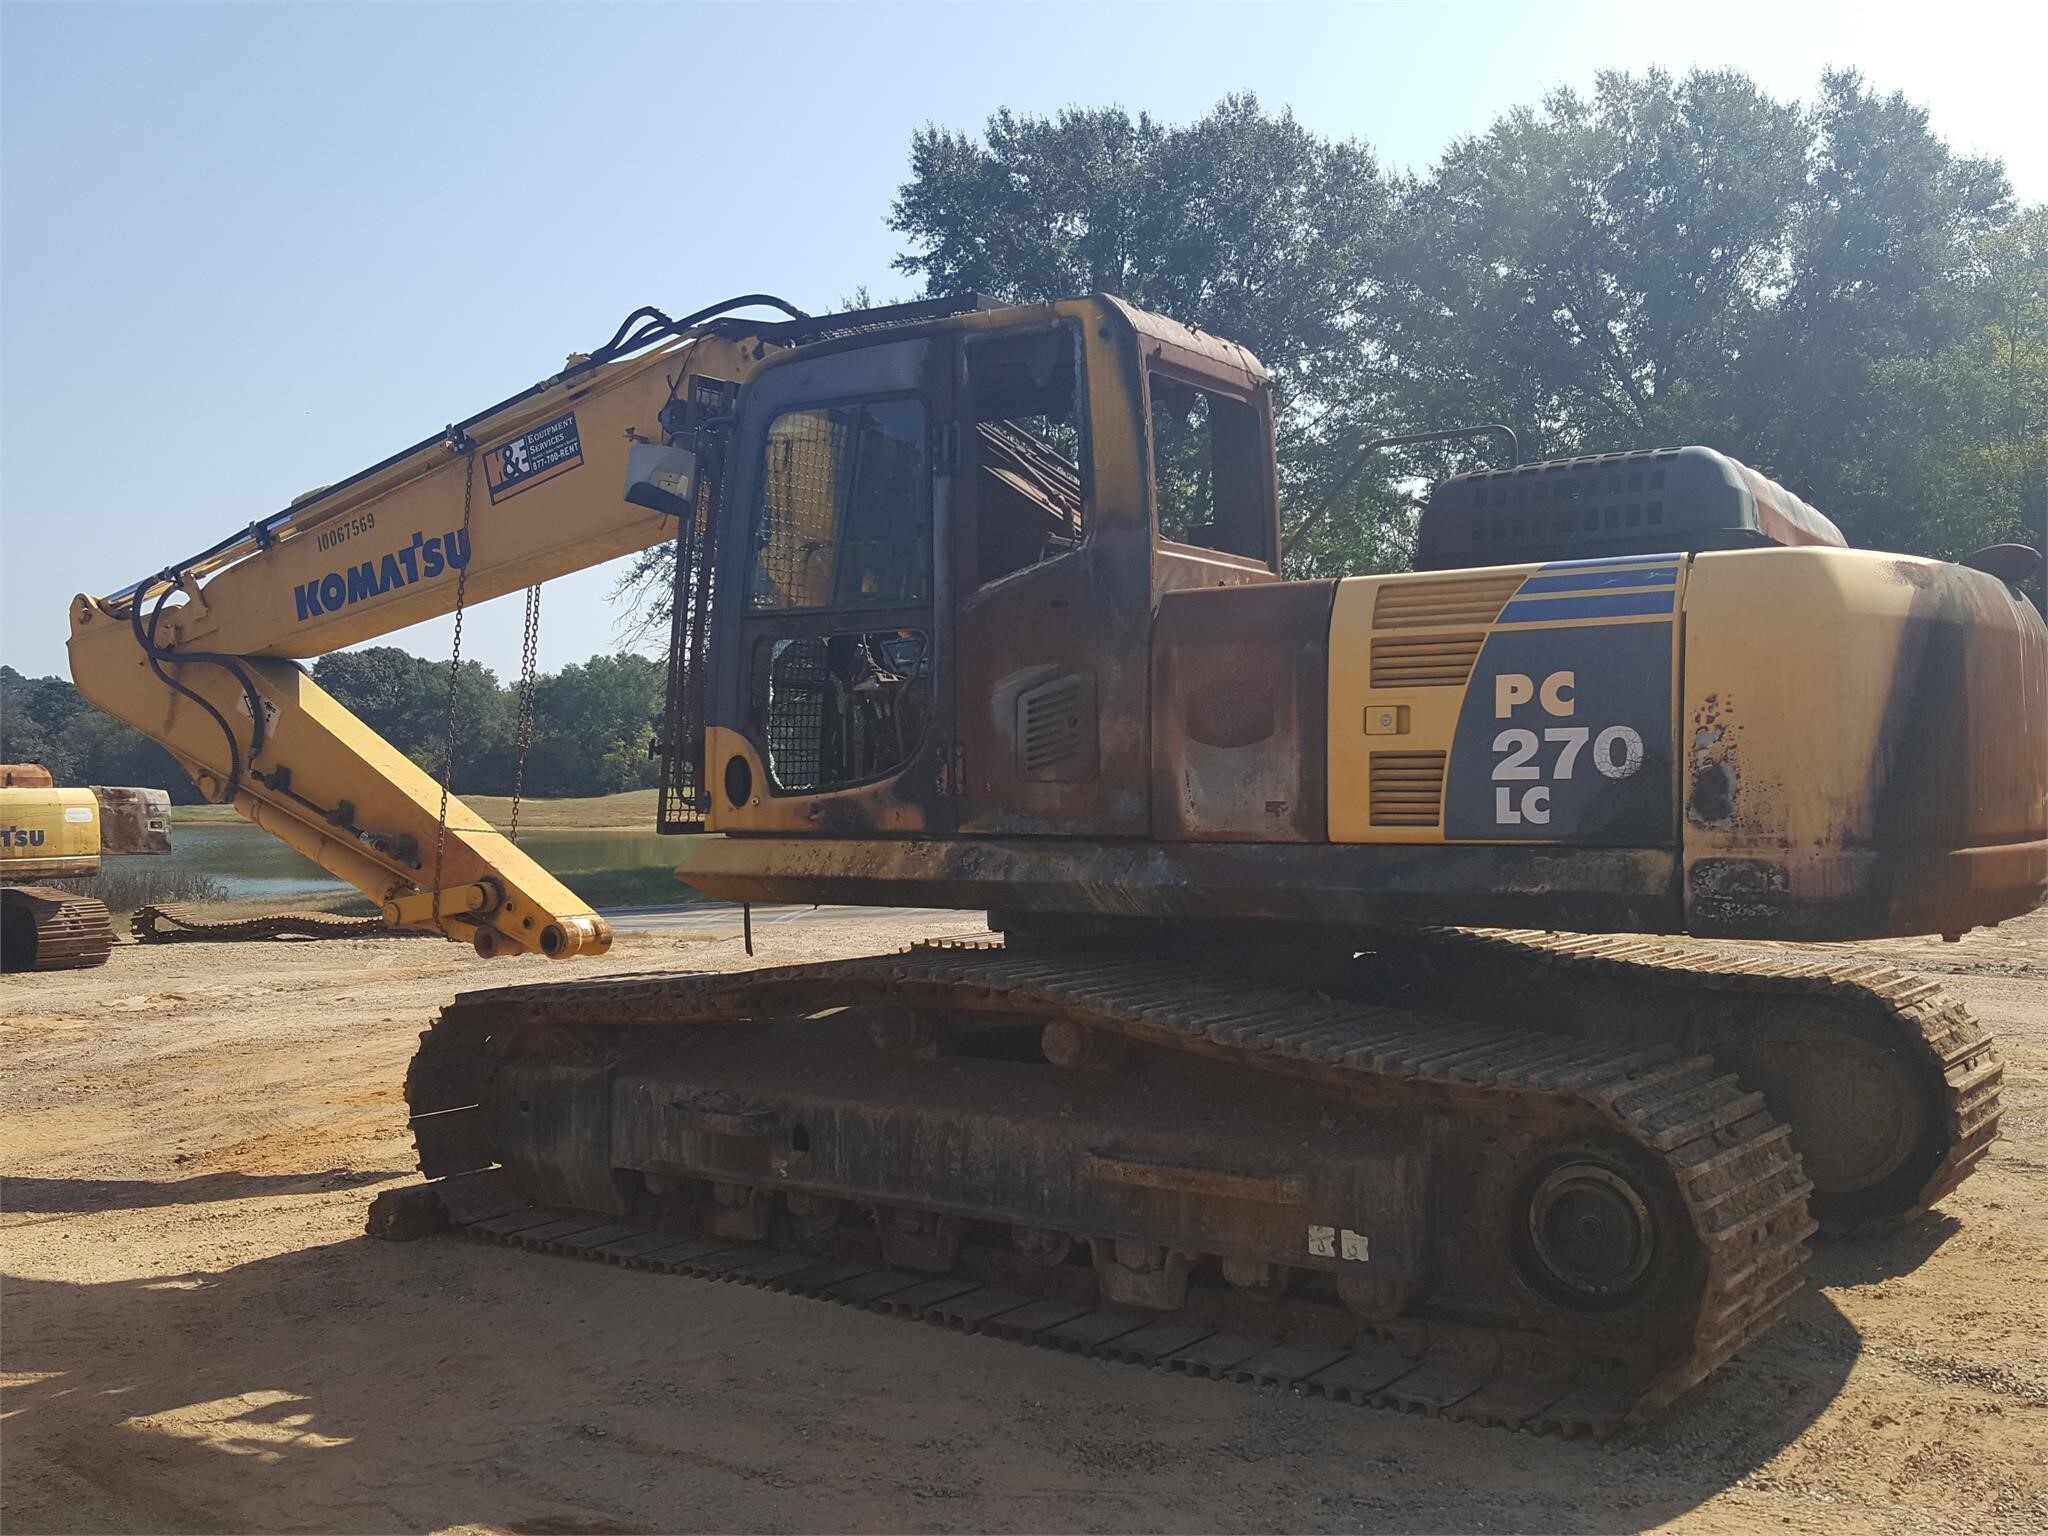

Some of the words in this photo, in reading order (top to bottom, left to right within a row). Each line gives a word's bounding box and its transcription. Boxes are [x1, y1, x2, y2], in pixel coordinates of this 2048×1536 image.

[527, 417, 574, 444] EQUIPMENT
[529, 433, 565, 454] SERVICES
[485, 438, 530, 487] H&E
[317, 512, 375, 552] 10067569
[294, 527, 471, 621] KOMATSU
[1495, 671, 1575, 718] PC
[1491, 725, 1644, 780] 270
[1495, 786, 1550, 824] LC
